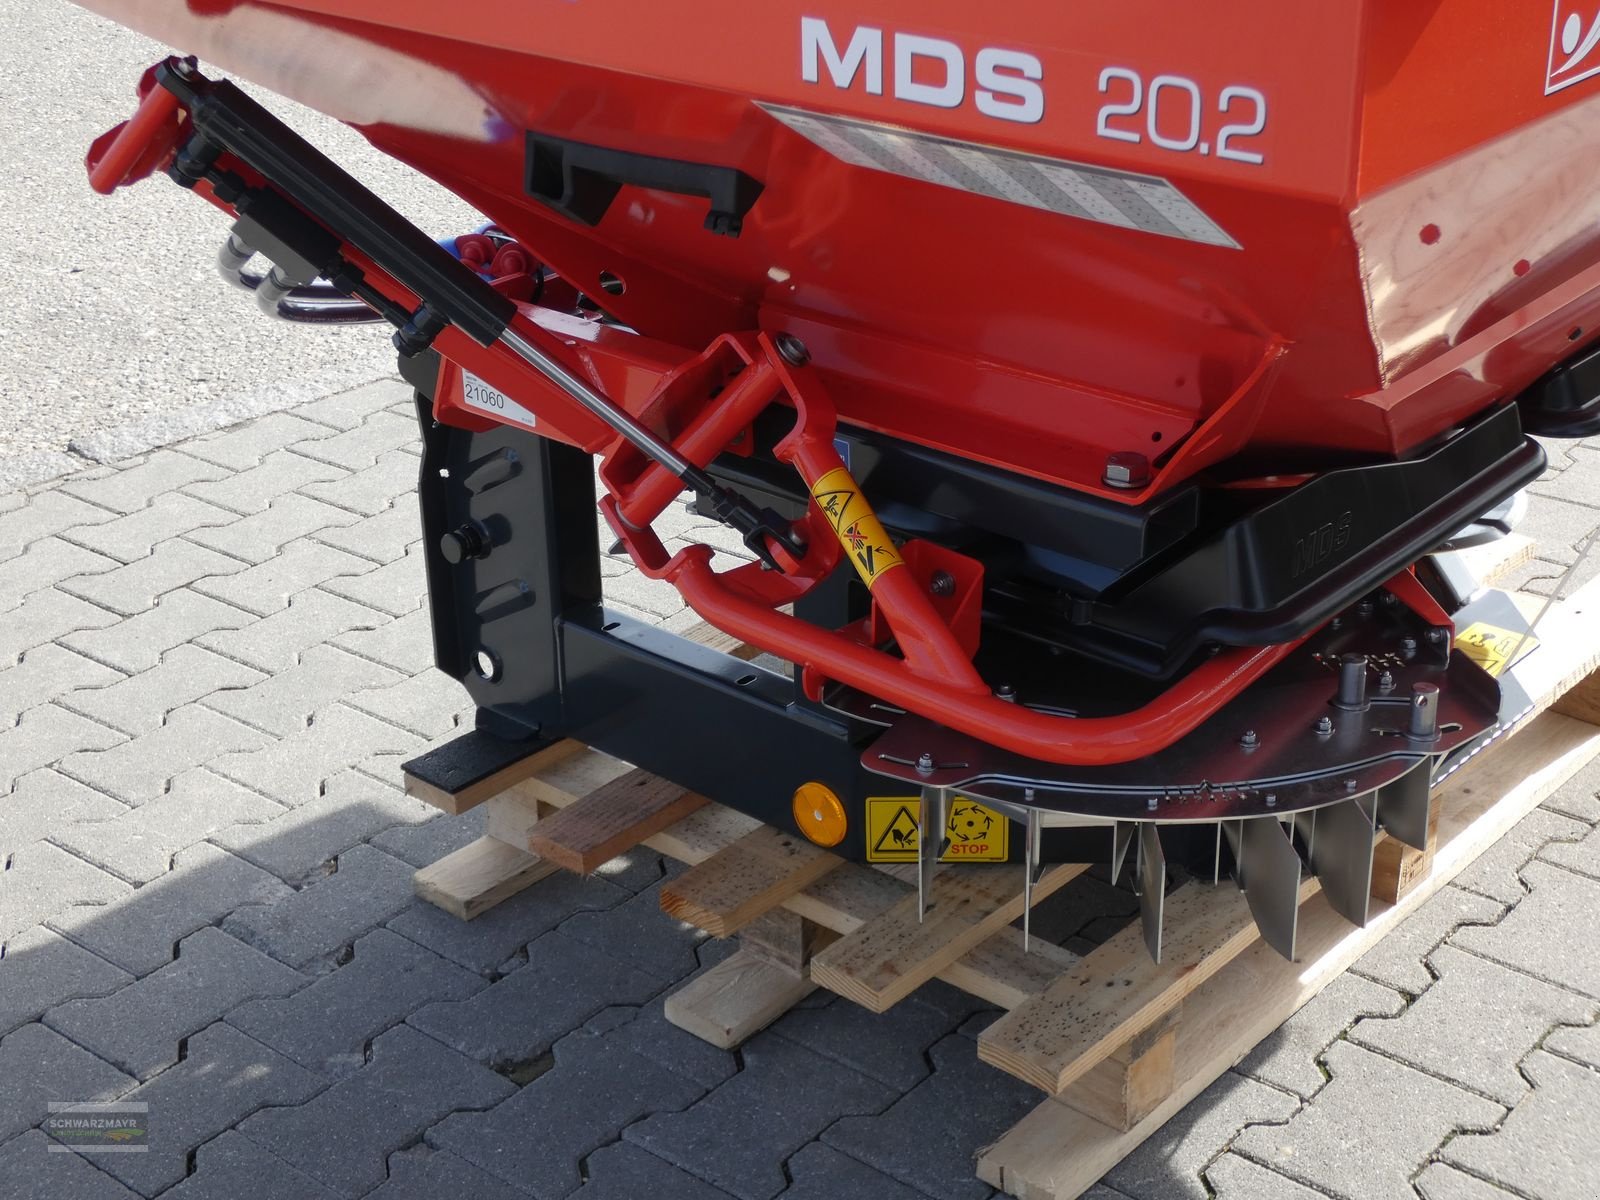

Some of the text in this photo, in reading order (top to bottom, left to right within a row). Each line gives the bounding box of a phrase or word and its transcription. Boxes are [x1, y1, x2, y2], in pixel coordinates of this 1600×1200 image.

[801, 16, 1267, 165] MDS 20.2
[465, 383, 505, 409] 21060
[1292, 511, 1351, 578] MDS
[951, 844, 989, 855] STOP
